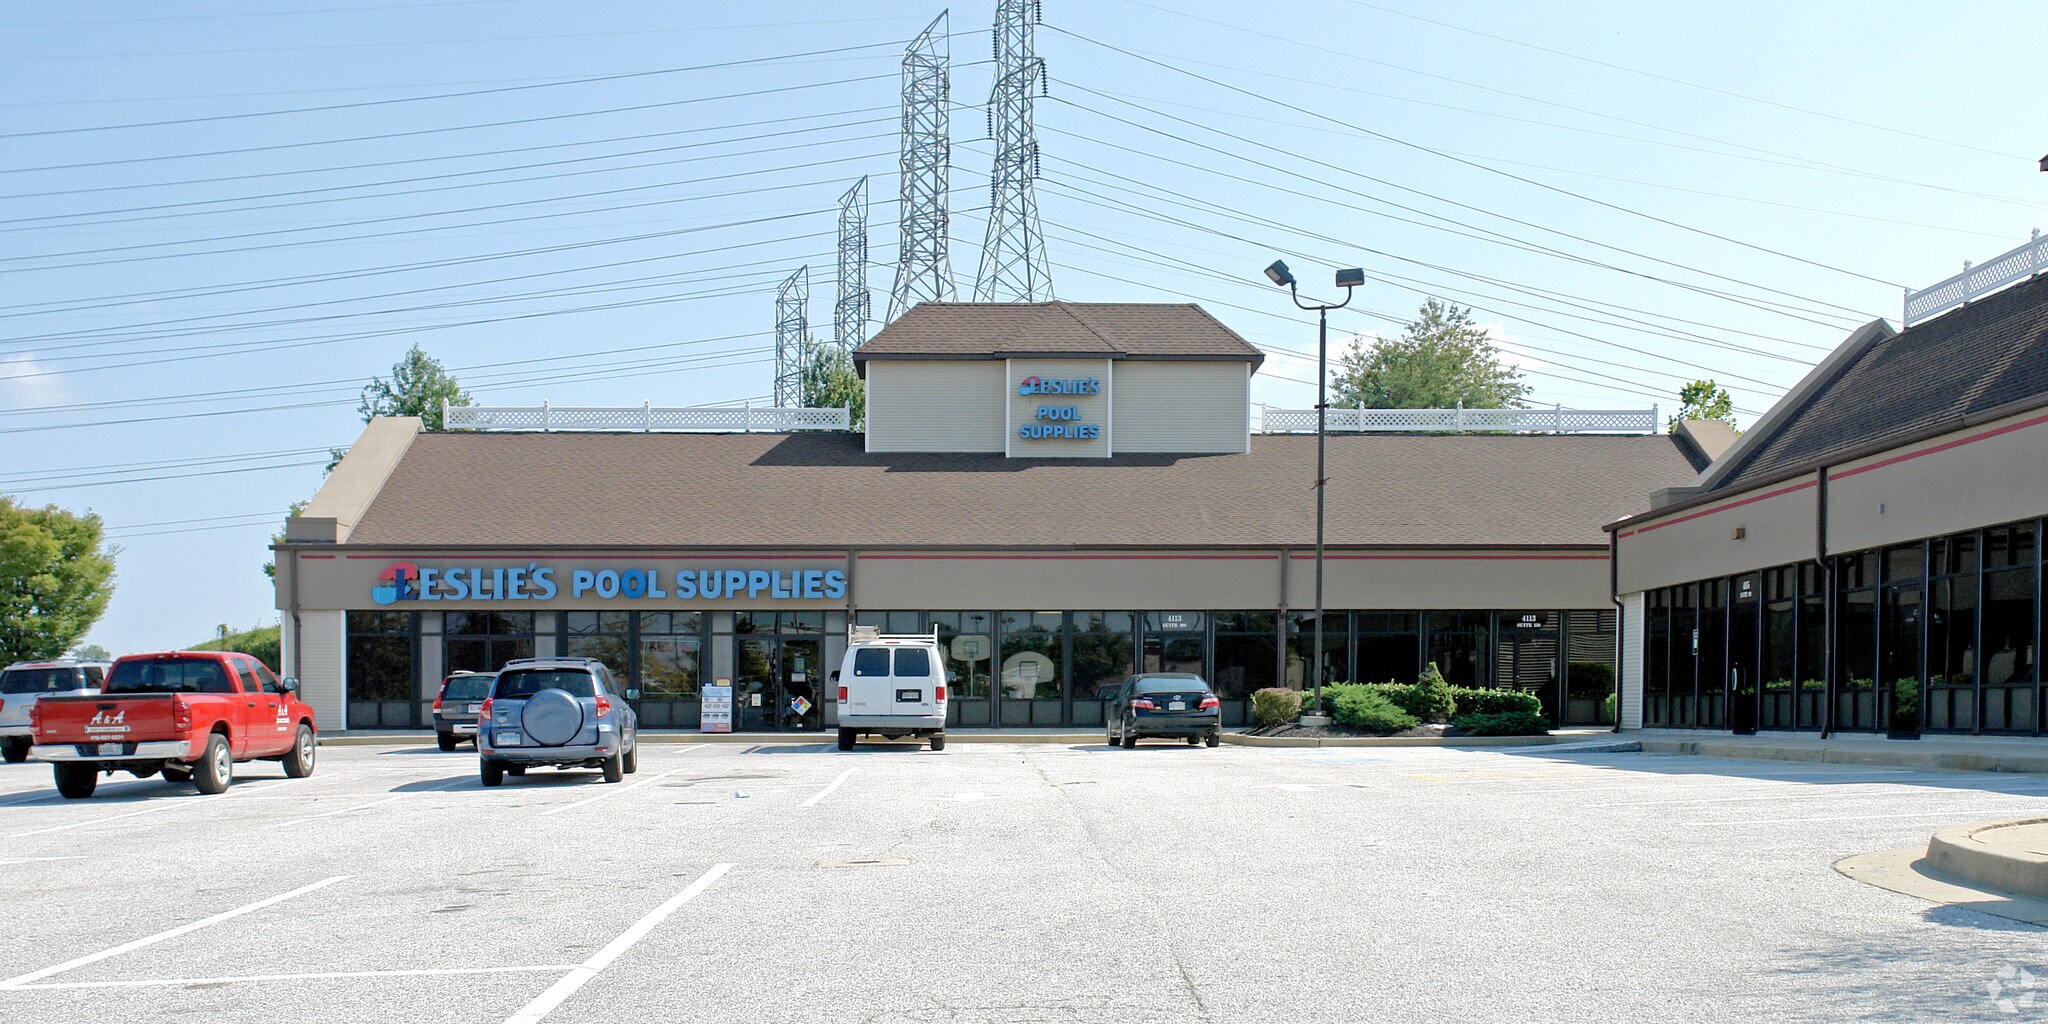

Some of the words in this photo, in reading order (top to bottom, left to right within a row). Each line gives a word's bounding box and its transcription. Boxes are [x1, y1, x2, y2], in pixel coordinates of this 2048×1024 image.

[1029, 377, 1101, 396] LESLIE'S
[1037, 405, 1082, 421] POOL
[1020, 424, 1099, 439] SUPPLIES
[394, 562, 558, 602] LESLIE'S
[572, 568, 667, 600] POOL
[675, 568, 846, 600] SUPPLIES
[89, 710, 103, 725] A
[111, 710, 125, 725] A
